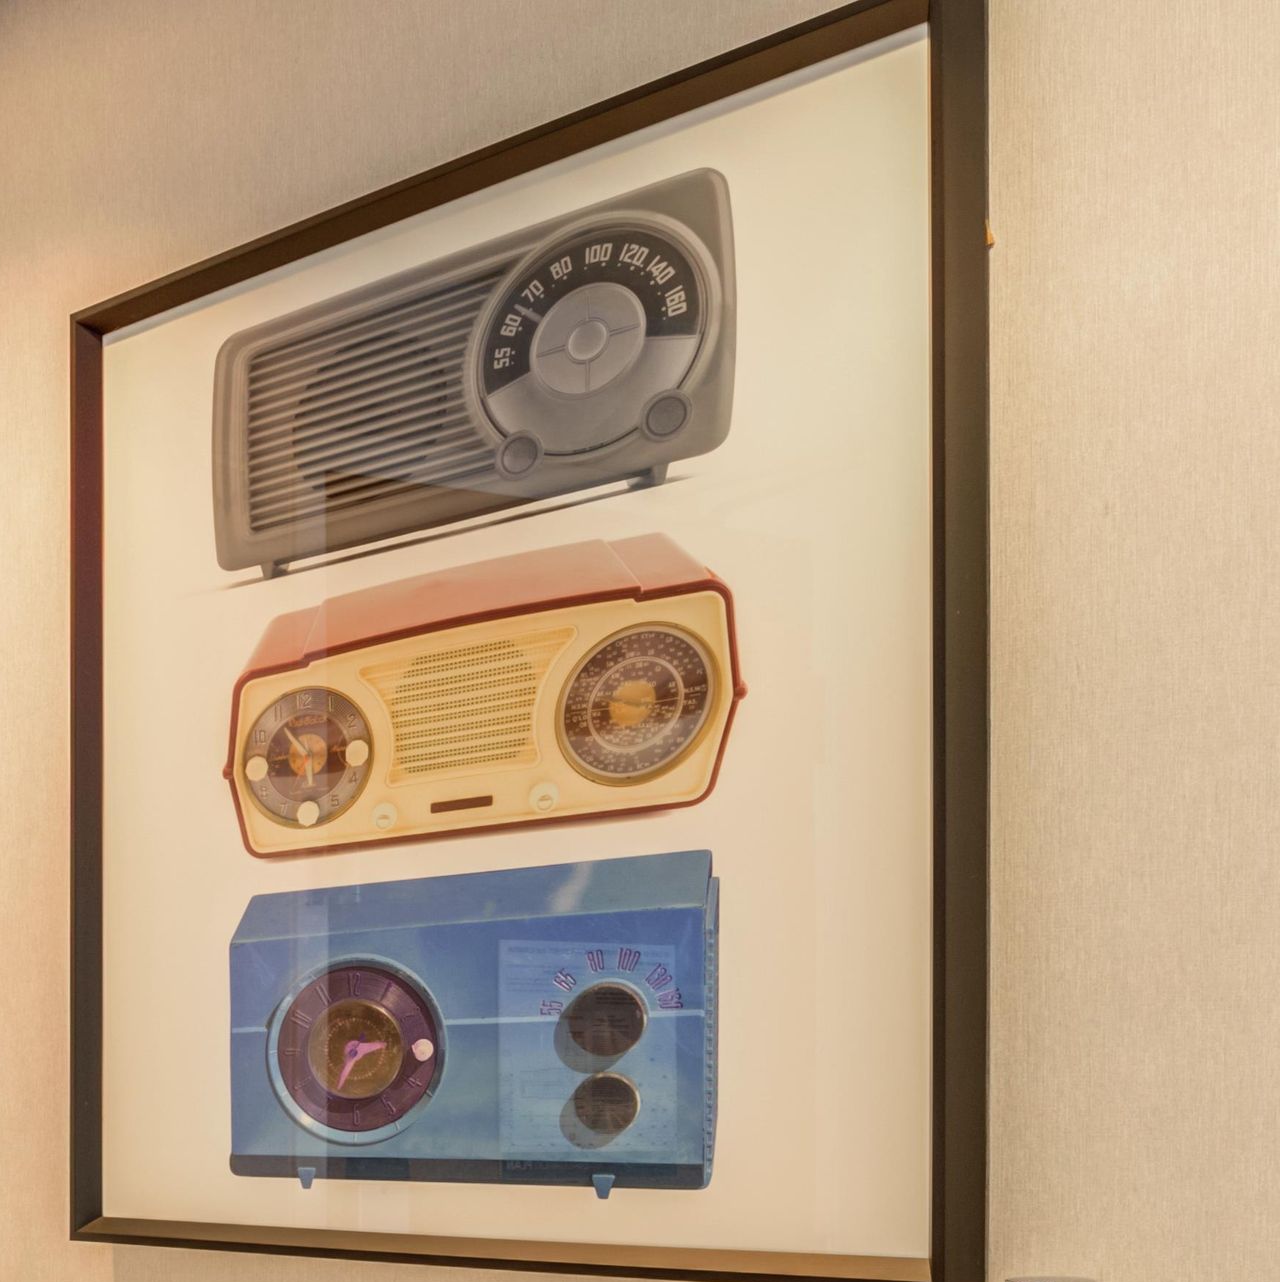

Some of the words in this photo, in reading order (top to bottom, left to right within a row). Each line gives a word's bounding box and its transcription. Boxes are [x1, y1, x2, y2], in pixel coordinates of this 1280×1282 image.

[585, 242, 613, 264] 100
[620, 243, 649, 266] 120
[550, 256, 572, 280] 80
[647, 256, 676, 285] 140
[521, 280, 544, 303] 70
[665, 285, 687, 317] 160
[500, 315, 522, 337] 60
[494, 347, 511, 369] 55
[296, 694, 312, 709] 12
[330, 794, 340, 808] 5
[348, 972, 361, 996] 12
[540, 999, 564, 1016] 55
[585, 949, 605, 973] 80
[617, 947, 641, 972] 100
[645, 963, 673, 990] 130
